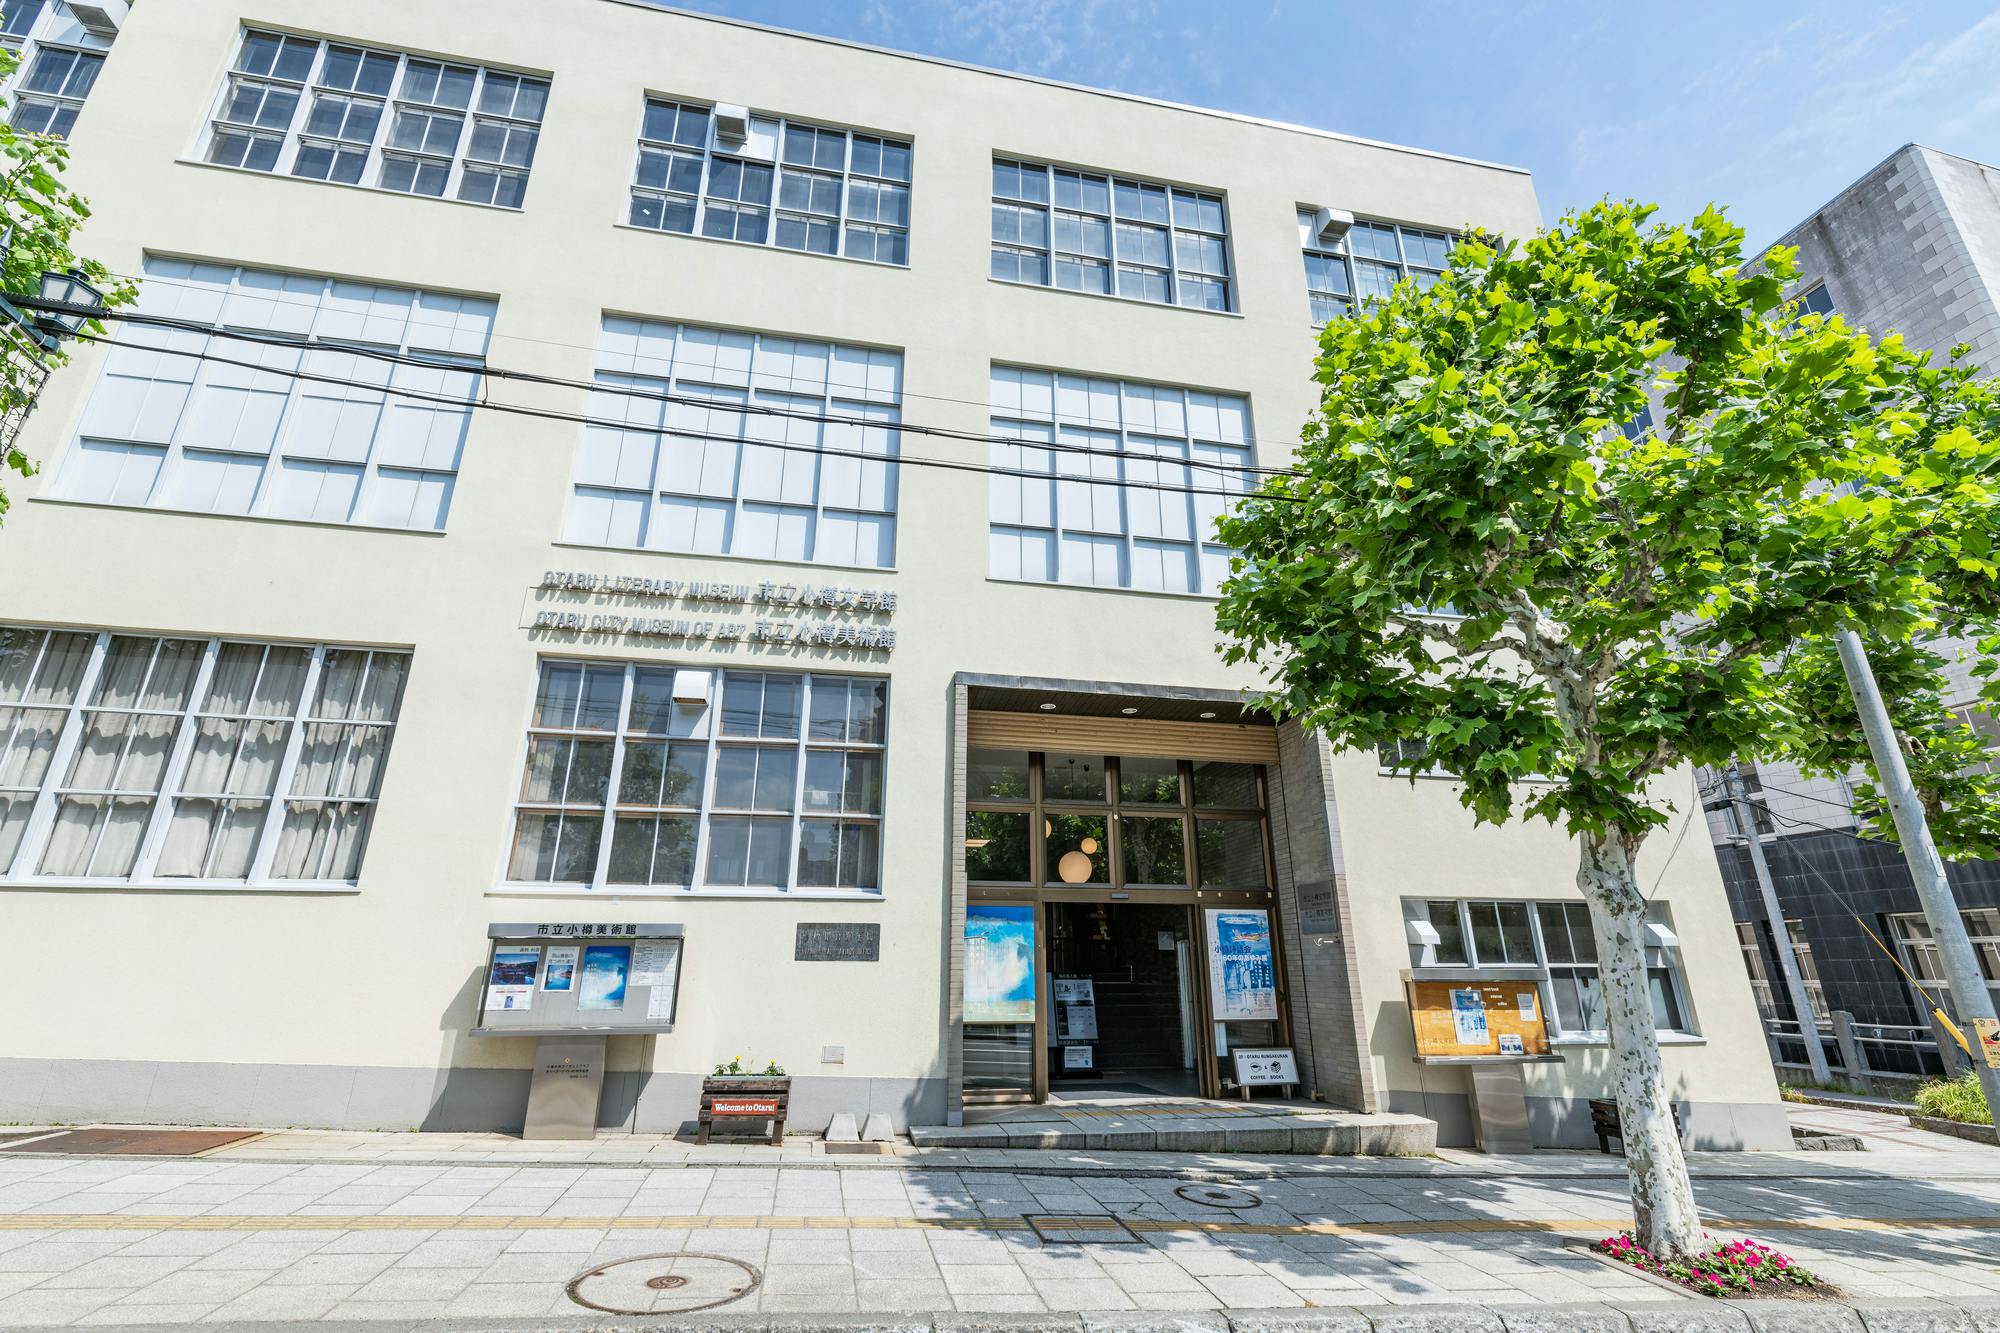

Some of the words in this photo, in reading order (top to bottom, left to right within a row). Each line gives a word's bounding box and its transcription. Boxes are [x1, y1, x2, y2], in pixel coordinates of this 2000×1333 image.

[543, 570, 597, 588] OTARU
[602, 574, 684, 595] LITERARY
[688, 581, 750, 600] MUSEUM
[758, 580, 898, 612] 市立小樽文学館
[536, 610, 588, 629] OTARU
[591, 614, 629, 632] CITY
[631, 617, 690, 637] MUSEUM
[693, 621, 713, 637] OF
[718, 623, 747, 639] ART
[755, 618, 897, 648] 市立小樽美術館
[537, 924, 637, 935] 市立小樽美術館
[715, 1103, 745, 1111] Welcome
[753, 1103, 775, 1111] Otaru!
